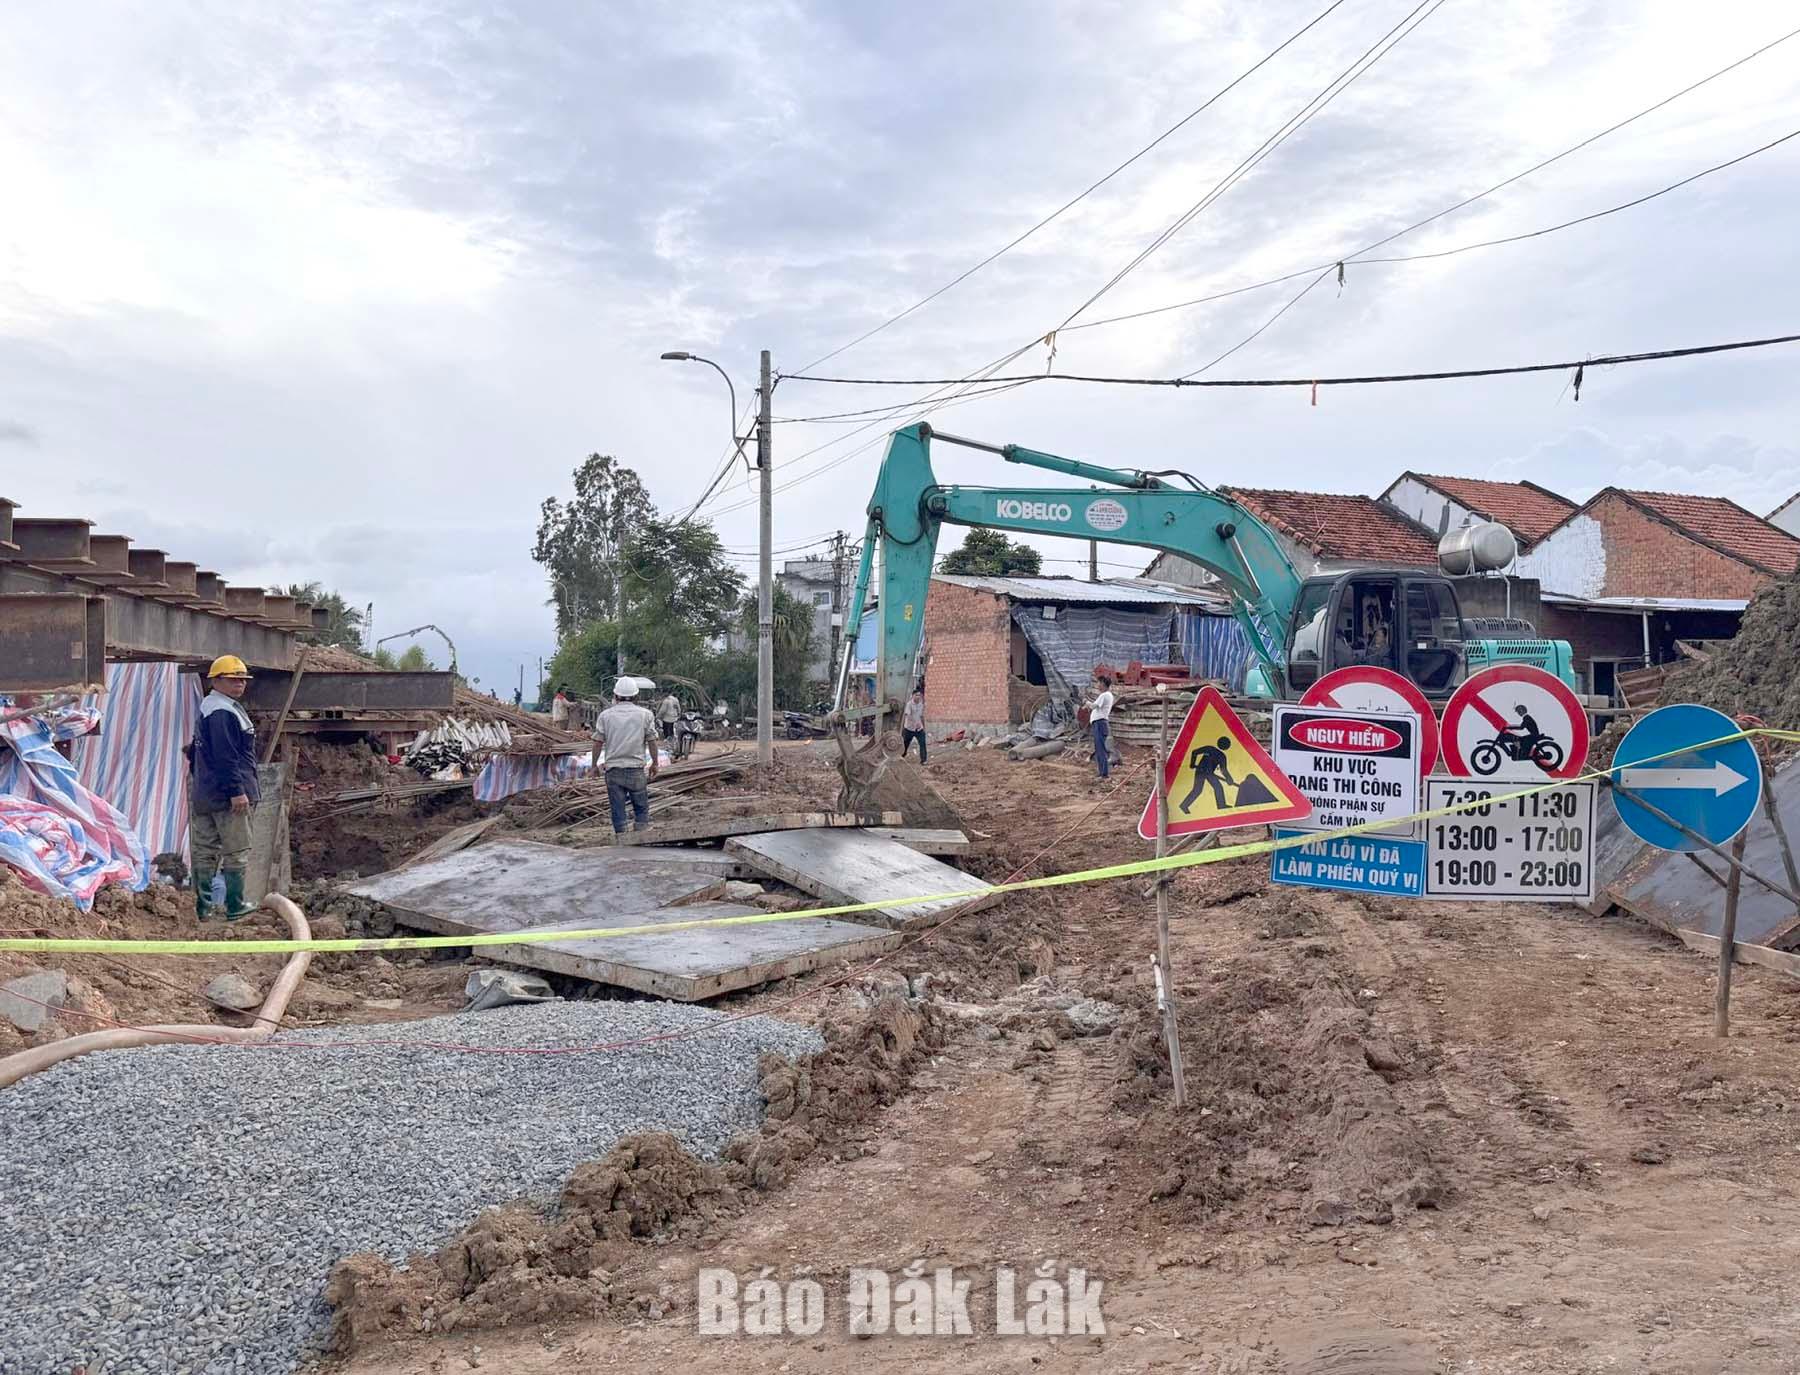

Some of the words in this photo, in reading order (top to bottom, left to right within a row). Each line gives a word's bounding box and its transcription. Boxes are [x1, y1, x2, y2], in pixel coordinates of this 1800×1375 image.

[996, 499, 1072, 522] KOBELCO
[1307, 727, 1345, 744] NGUY
[1349, 726, 1385, 748] HIỂM
[1313, 756, 1343, 773] KHU
[1348, 758, 1377, 778] VỰC
[1333, 779, 1356, 794] THI
[1361, 778, 1402, 797] CÔNG
[1307, 796, 1337, 809] HÔNG
[1340, 798, 1368, 813] PHẬN
[1371, 801, 1385, 815] SỰ
[1442, 790, 1491, 816] 7:30
[1517, 792, 1577, 818] 11:30
[1320, 811, 1343, 826] CẤM
[1435, 825, 1497, 851] 13:00
[1521, 826, 1583, 852] 17:00
[1300, 840, 1327, 857] XIN
[1332, 839, 1355, 860] LỖI
[1360, 844, 1375, 863] VÌ
[1379, 846, 1400, 865] ĐÃ
[1279, 857, 1312, 877] LÀM
[1368, 868, 1399, 887] QUÝ
[1403, 872, 1418, 892] VỊ
[1435, 860, 1497, 886] 19:00
[1520, 861, 1582, 887] 23:00
